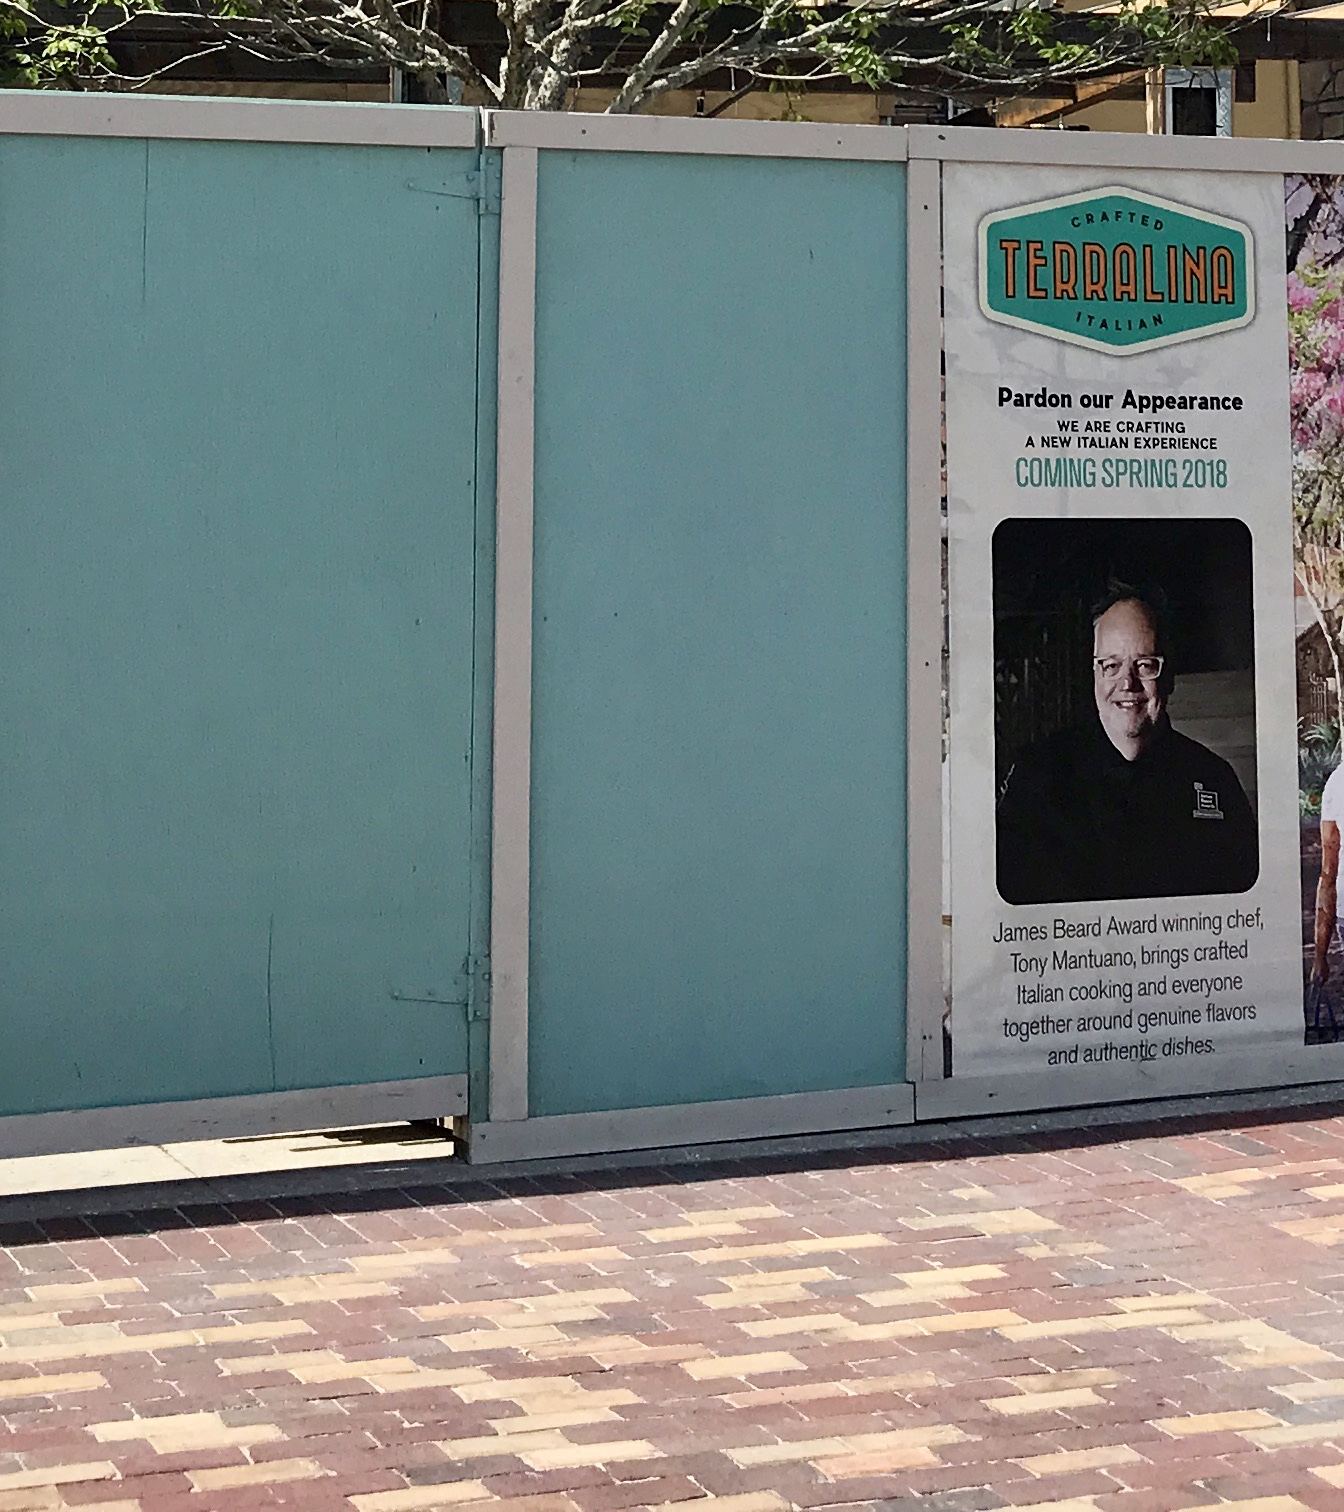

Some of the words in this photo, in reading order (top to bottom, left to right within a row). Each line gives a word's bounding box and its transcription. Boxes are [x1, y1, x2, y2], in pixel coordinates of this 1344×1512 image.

[1071, 210, 1164, 230] CRAFTED
[1000, 239, 1235, 304] TERRALINA
[1076, 312, 1163, 331] ITALIAN
[998, 387, 1072, 408] Pardon
[1079, 394, 1113, 408] our
[1121, 389, 1243, 413] Appearance
[1057, 420, 1079, 432] WE
[1085, 421, 1111, 433] ARE
[1116, 421, 1186, 434] CRAFTING
[1025, 436, 1035, 448] A
[1041, 437, 1071, 448] NEW
[1078, 437, 1129, 448] ITALIAN
[1134, 438, 1217, 449] EXPERIENCE
[1015, 457, 1096, 488] COMING
[1101, 458, 1178, 488] SPRING
[1182, 459, 1228, 488] 2018
[993, 922, 1048, 943] James
[1054, 916, 1101, 939] Beard
[1107, 914, 1156, 936] Award
[1162, 912, 1222, 935] winning
[1227, 907, 1264, 930] chef,
[1010, 953, 1048, 977] Tony
[1053, 949, 1136, 970] Mantuano,
[1141, 944, 1188, 969] brings
[1194, 940, 1248, 962] crafted
[1017, 983, 1064, 1004] Italian
[1069, 979, 1132, 1003] cooking
[1138, 975, 1167, 996] and
[1172, 976, 1243, 998] everyone
[1003, 1015, 1072, 1042] together
[1077, 1009, 1132, 1032] around
[1138, 1006, 1201, 1034] genuine
[1206, 1003, 1256, 1022] flavors
[1048, 1044, 1078, 1065] and
[1083, 1039, 1157, 1063] authentic
[1162, 1036, 1215, 1056] dishes.
